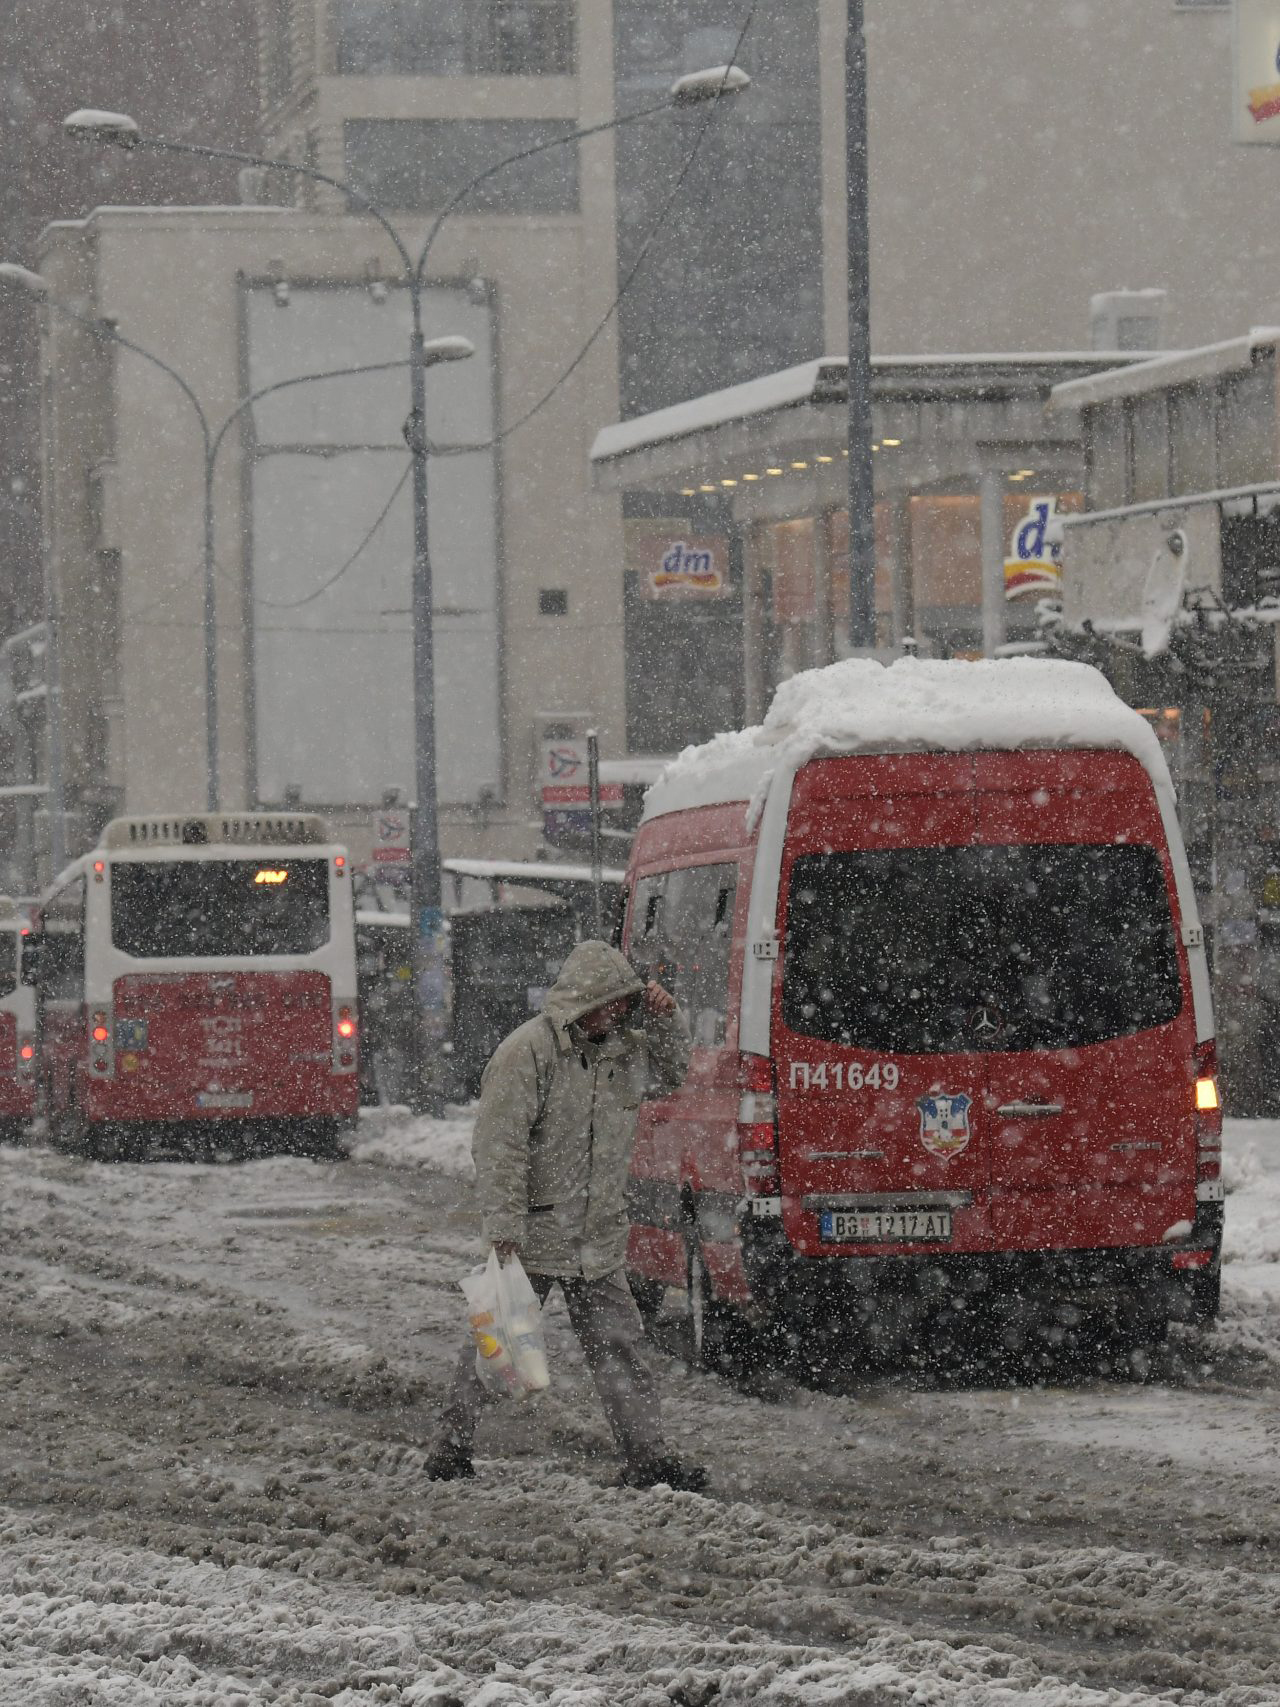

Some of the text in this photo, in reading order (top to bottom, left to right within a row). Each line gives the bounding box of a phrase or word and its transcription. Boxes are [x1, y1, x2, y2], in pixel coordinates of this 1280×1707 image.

[1017, 503, 1061, 560] d
[664, 544, 710, 573] dm
[789, 1062, 899, 1090] П41649
[835, 1216, 858, 1236] BG
